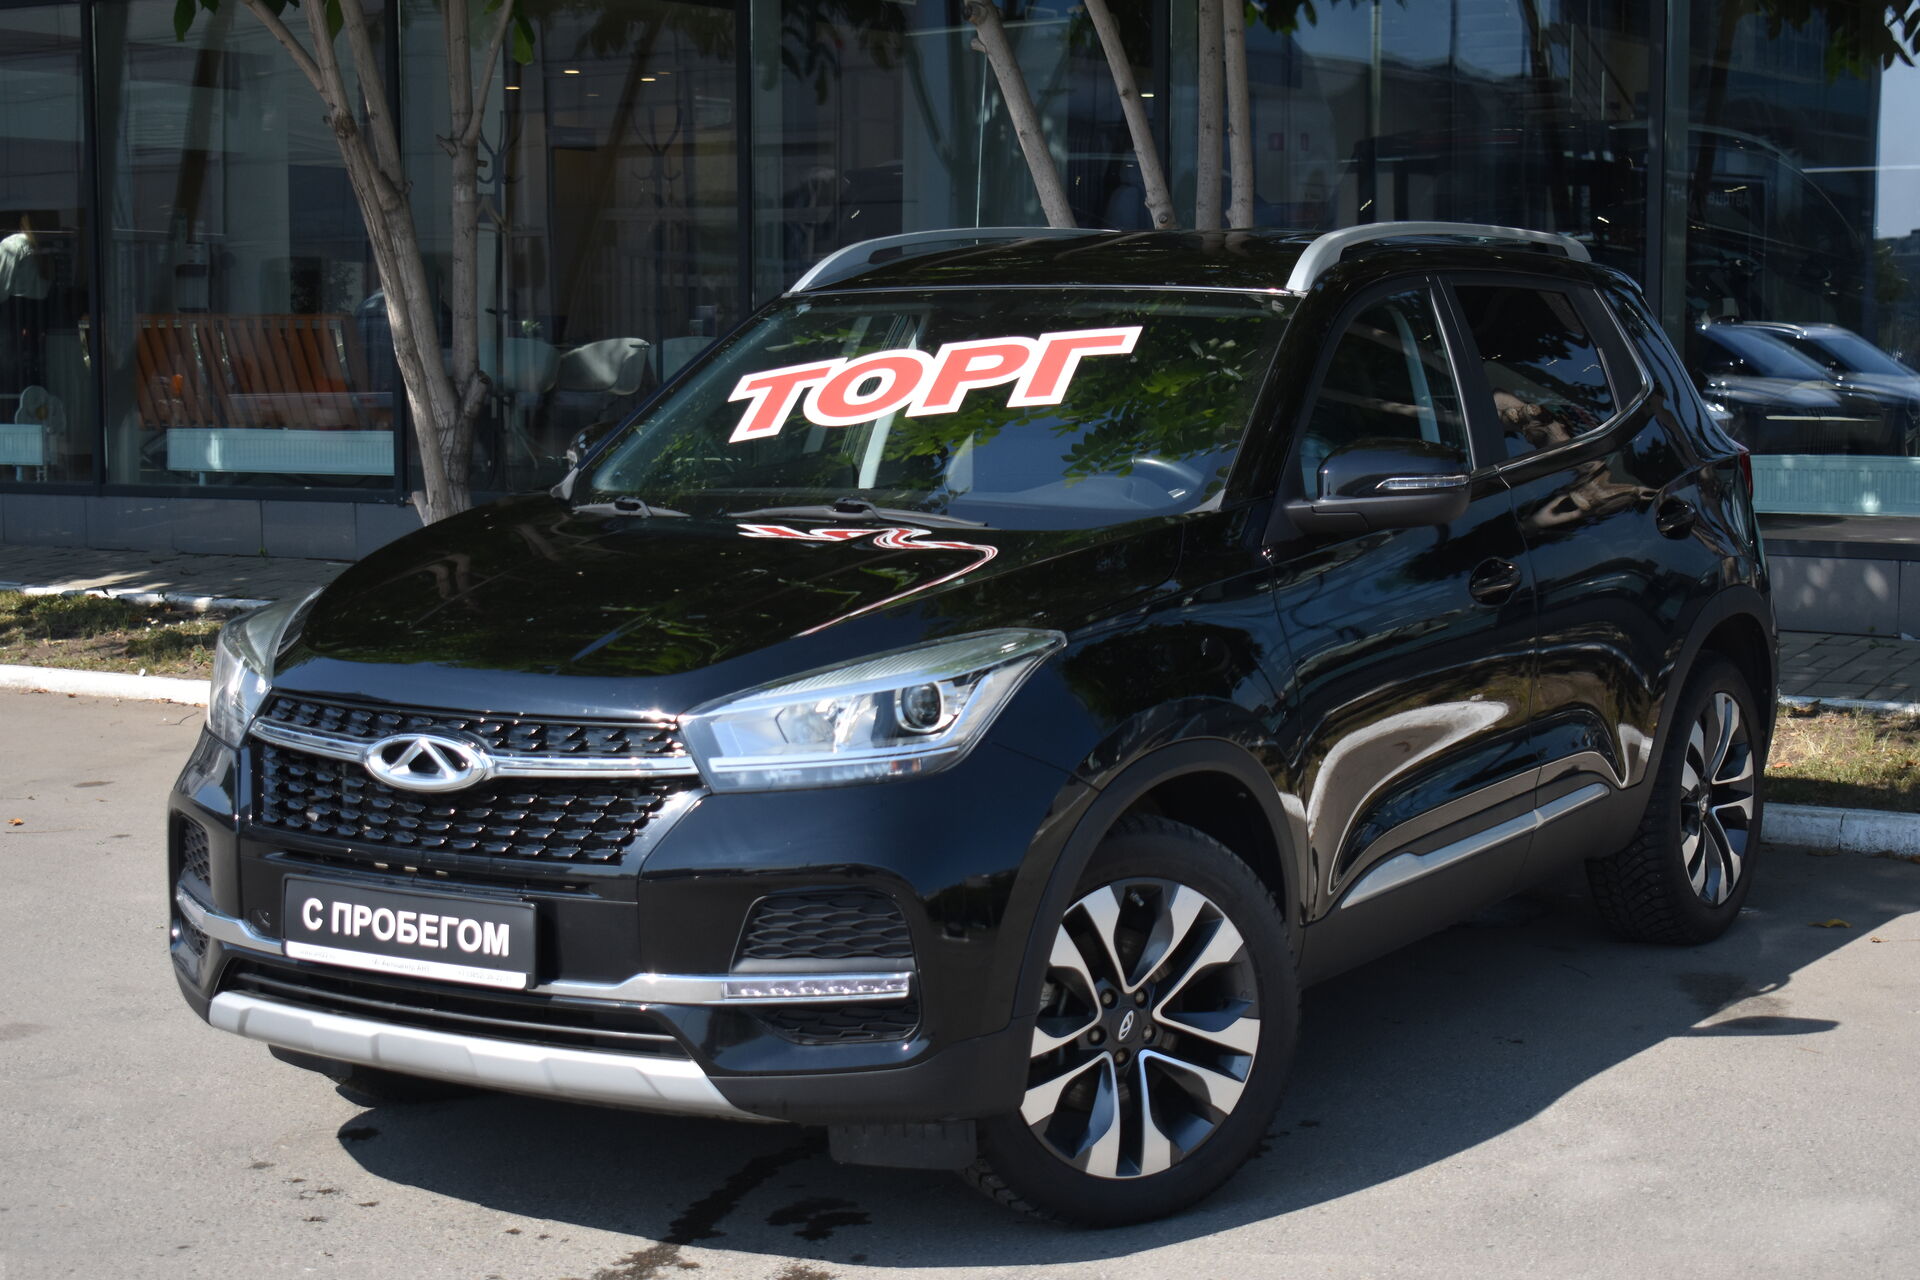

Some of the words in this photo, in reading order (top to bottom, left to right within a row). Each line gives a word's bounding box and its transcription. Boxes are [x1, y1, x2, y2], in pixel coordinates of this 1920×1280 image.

[729, 326, 1143, 443] ТОРГ
[302, 897, 324, 931] С
[331, 901, 510, 957] ПРОБЕГОМ
